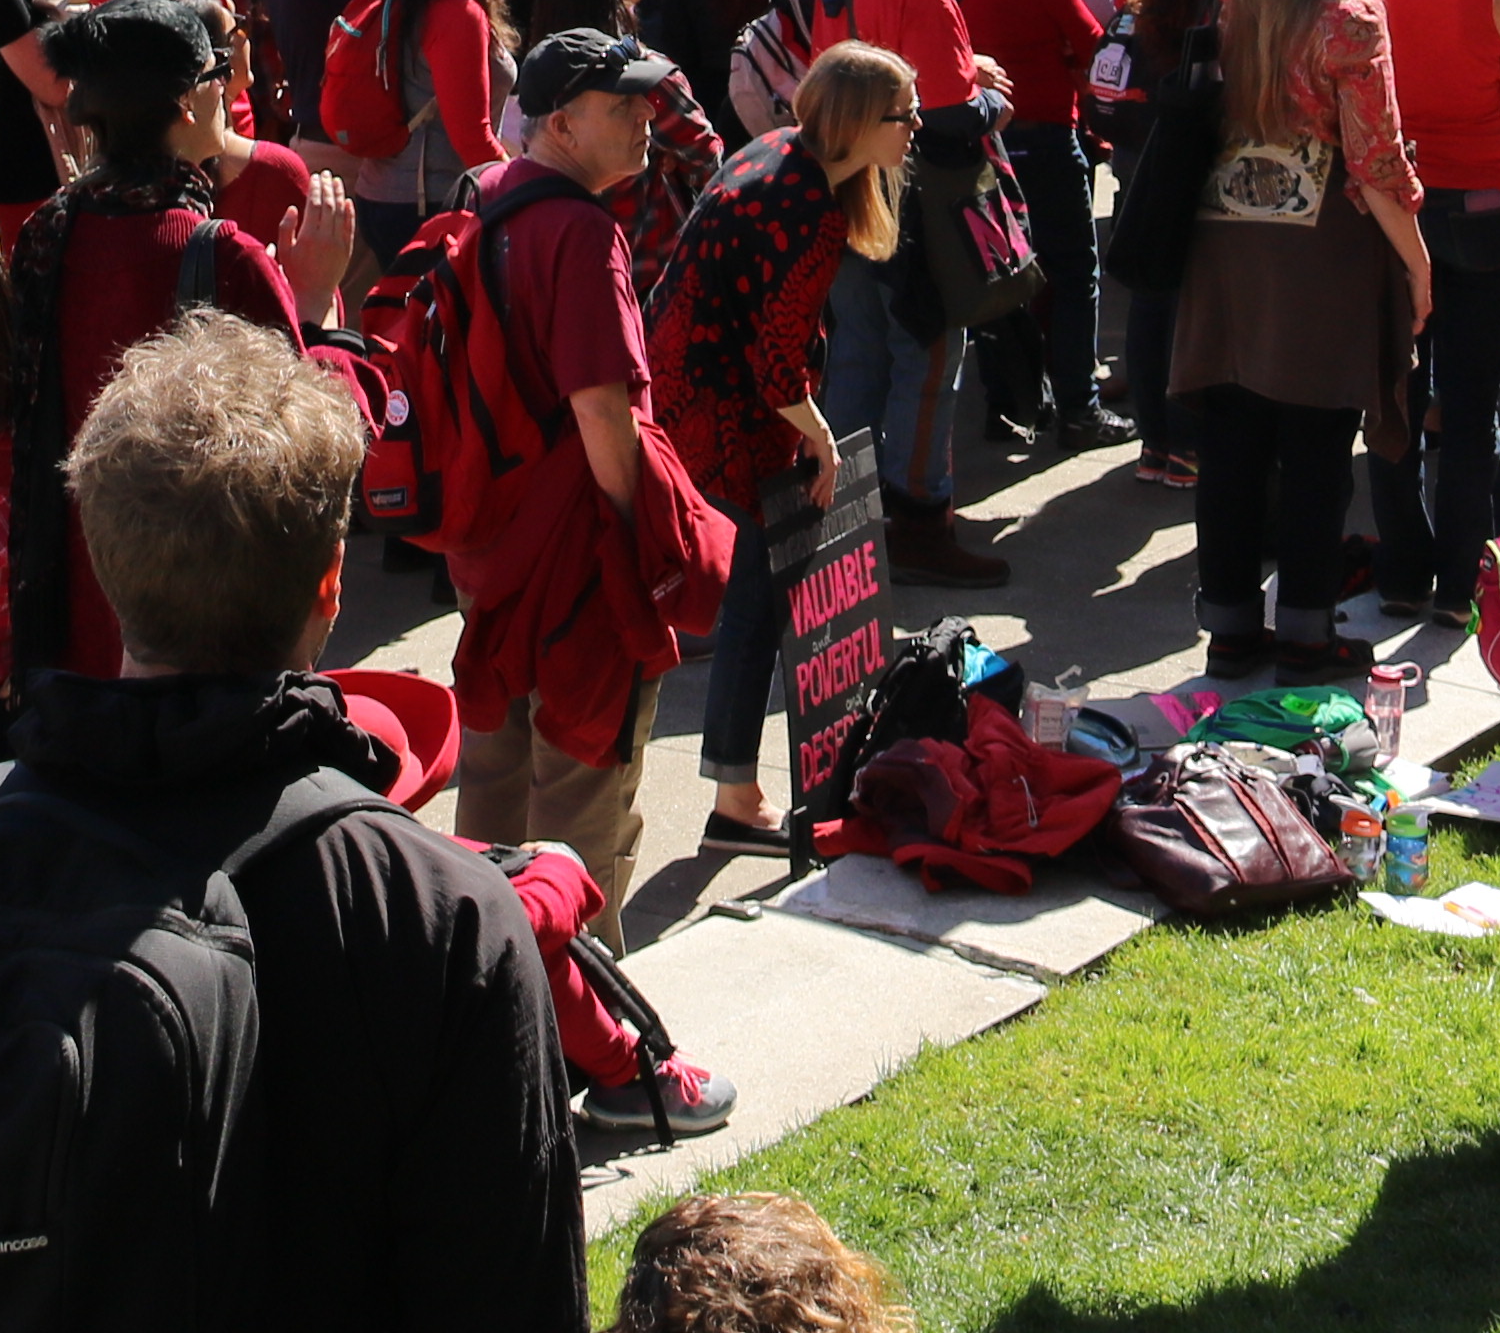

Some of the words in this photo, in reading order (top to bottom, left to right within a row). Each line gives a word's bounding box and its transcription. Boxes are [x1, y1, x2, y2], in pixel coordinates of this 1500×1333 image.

[787, 540, 879, 638] VALUABLE
[796, 617, 885, 716] POWERFUL
[813, 622, 832, 653] and
[0, 1235, 48, 1253] incase
